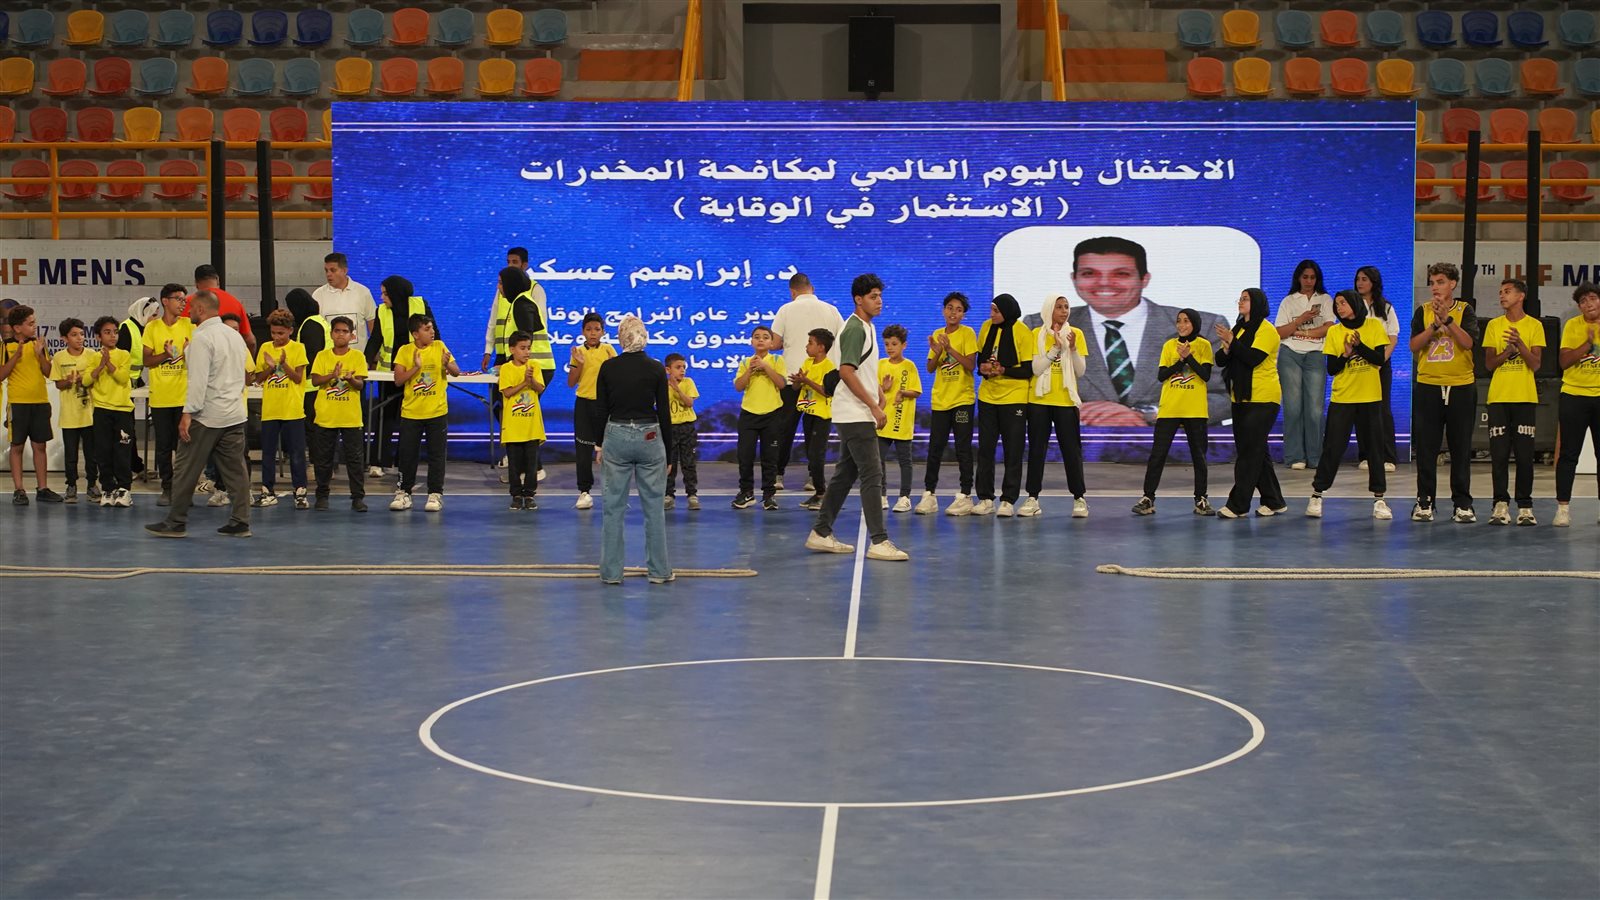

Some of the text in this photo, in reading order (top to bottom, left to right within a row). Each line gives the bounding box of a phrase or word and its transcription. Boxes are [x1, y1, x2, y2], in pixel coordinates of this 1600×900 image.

[520, 158, 1235, 191] الاحتفال باليوم العالمي لمكافحة المخدرات
[698, 196, 812, 224] الوقاية
[825, 197, 875, 229] في
[887, 194, 1043, 224] الاستثمار
[38, 258, 146, 285] MEN'S
[629, 259, 753, 289] إبراهيم
[690, 306, 728, 326] عام
[737, 310, 777, 325] دير
[687, 330, 753, 349] ندوق
[1427, 336, 1455, 362] 23
